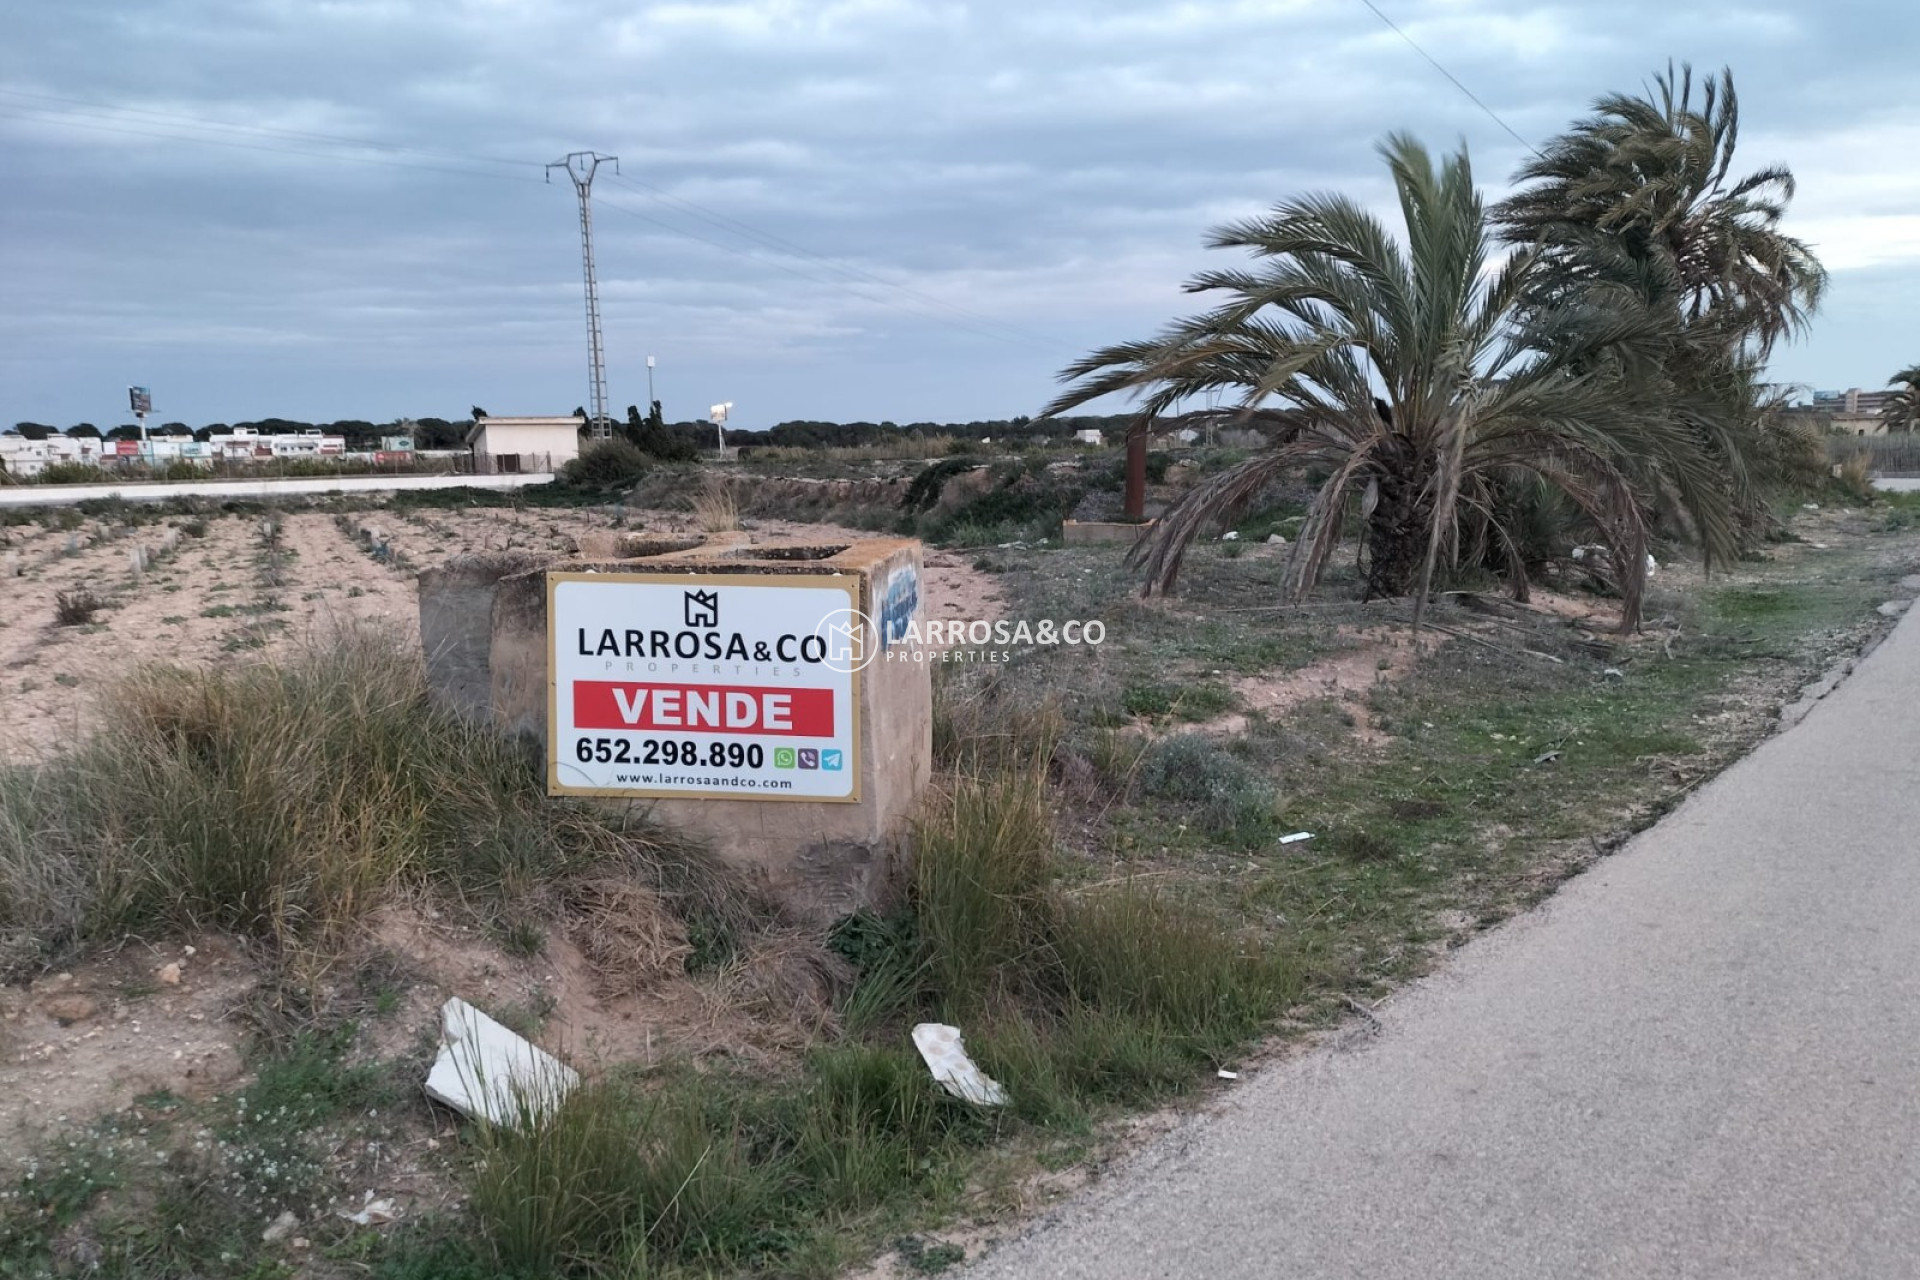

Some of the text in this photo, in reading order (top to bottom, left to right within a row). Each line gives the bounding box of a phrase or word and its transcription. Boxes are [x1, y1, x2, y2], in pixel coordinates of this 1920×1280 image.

[578, 628, 827, 663] LARROSA&CO
[605, 661, 800, 677] PROPERTIES
[612, 688, 793, 730] VENDE
[576, 737, 764, 769] 652.298.890
[617, 773, 792, 789] www.larrosaandco.com
